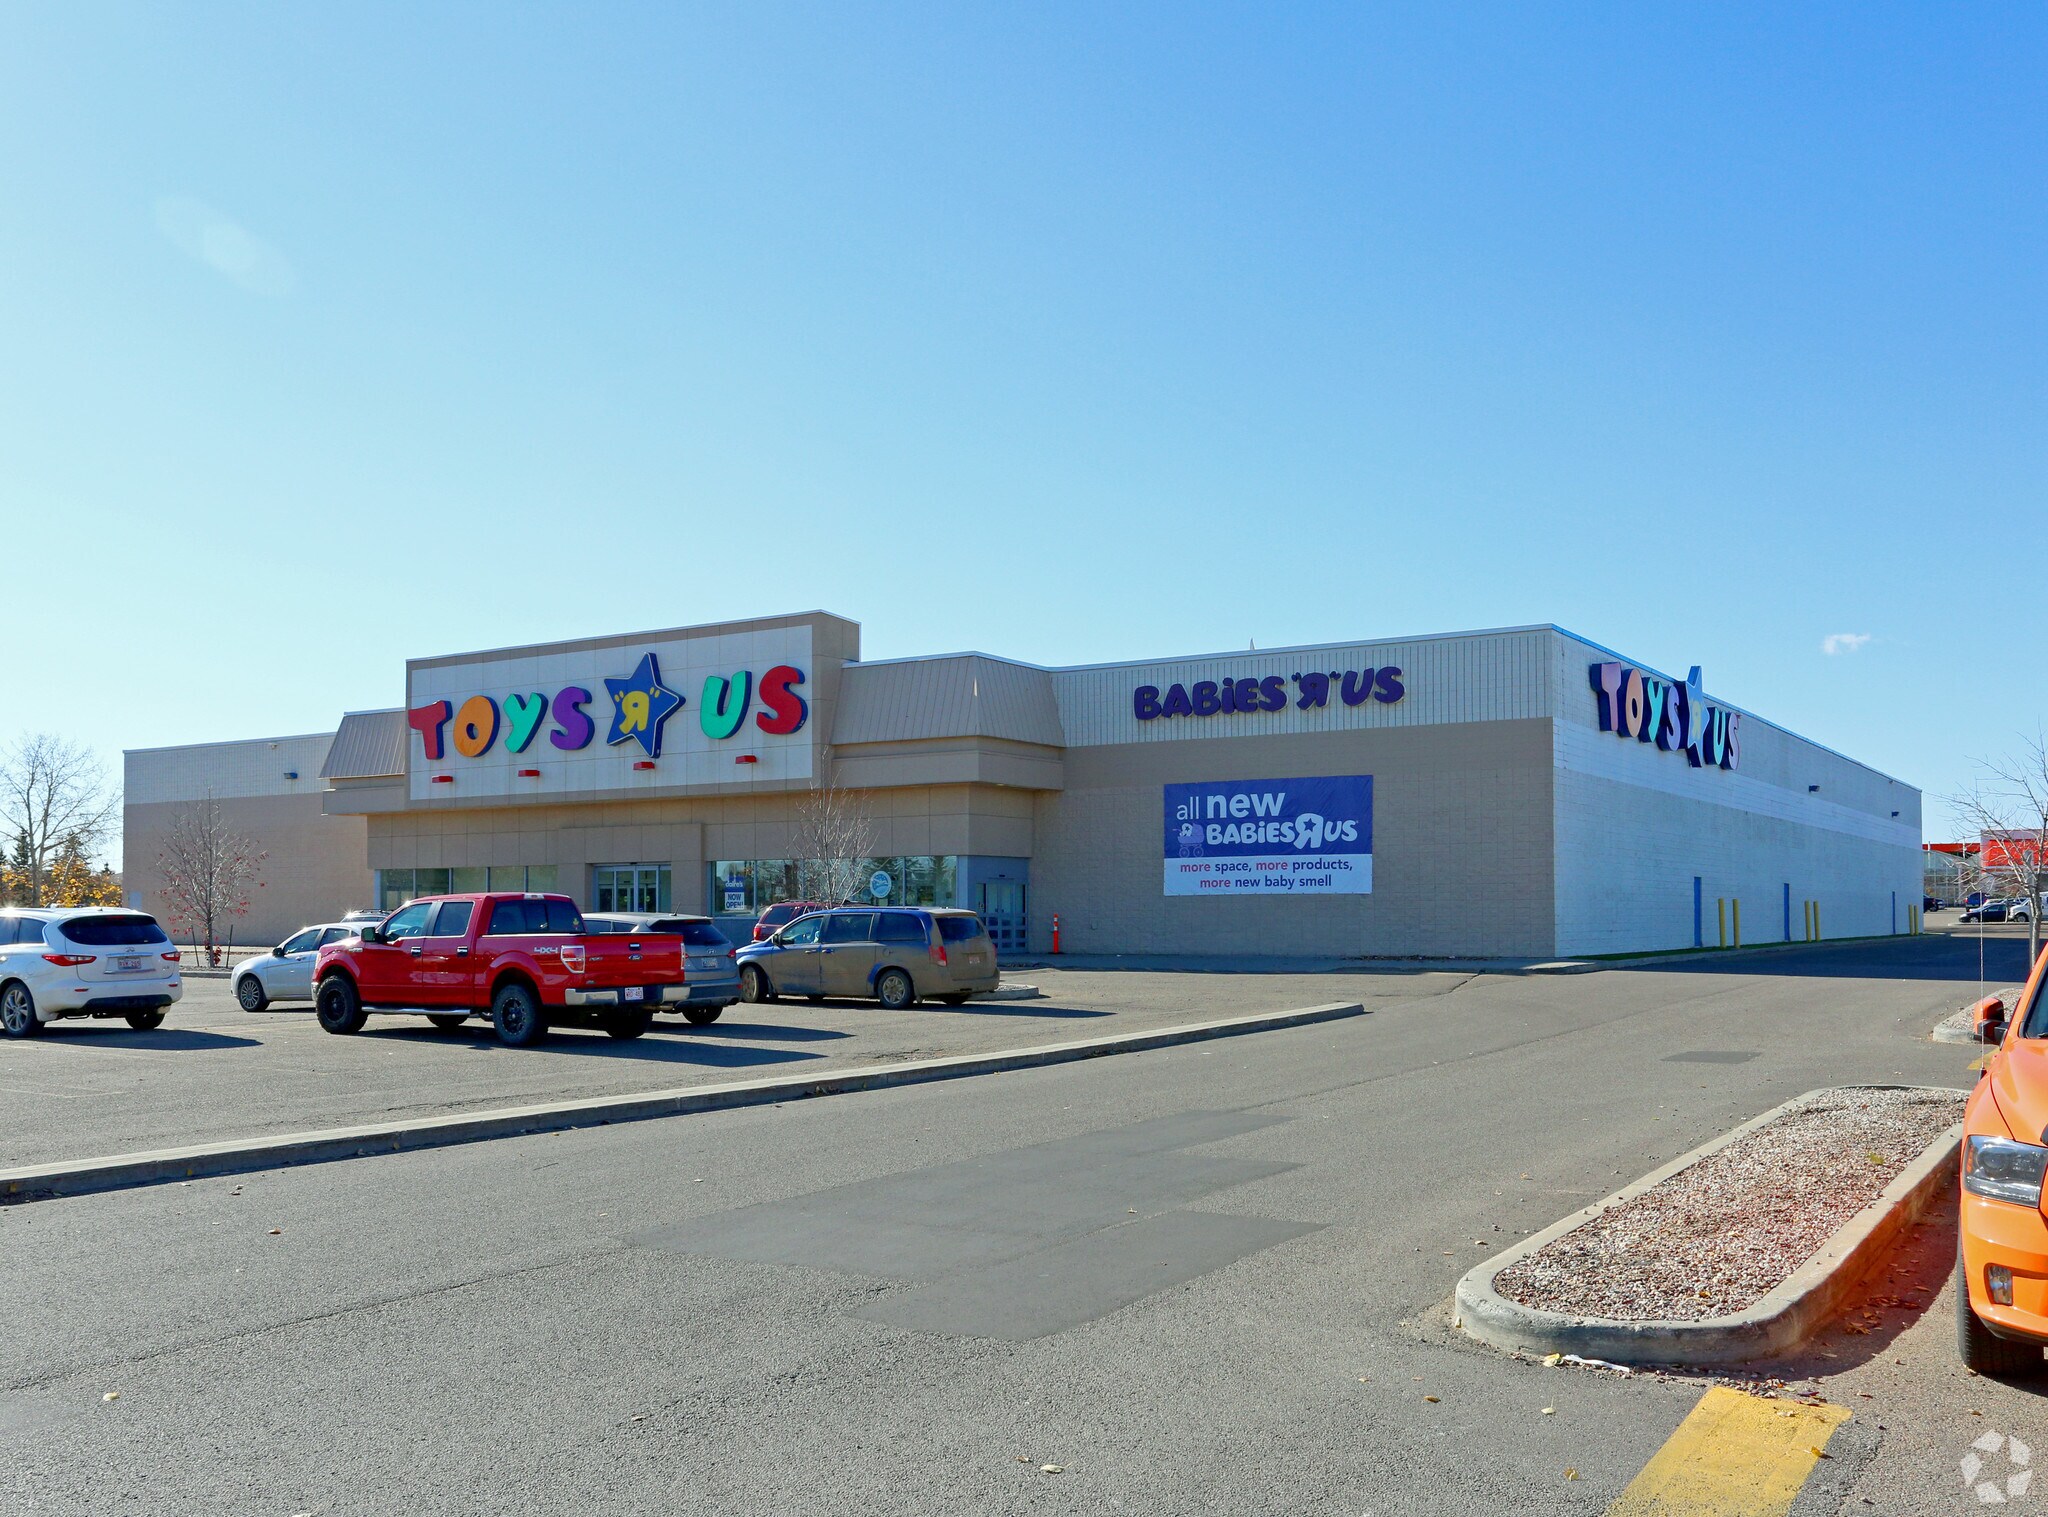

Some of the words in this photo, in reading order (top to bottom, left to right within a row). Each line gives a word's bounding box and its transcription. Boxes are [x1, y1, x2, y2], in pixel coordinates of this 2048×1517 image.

[1341, 666, 1406, 707] US
[408, 686, 595, 759] TOYS
[700, 665, 808, 739] US
[1590, 662, 1681, 751] TOYS
[1704, 706, 1740, 770] US
[1176, 796, 1200, 820] all
[1206, 792, 1286, 819] new
[1180, 862, 1211, 873] more
[1214, 861, 1252, 875] space,
[1255, 861, 1288, 872] more
[1292, 859, 1353, 875] products,
[1200, 877, 1231, 889] more
[1235, 877, 1260, 888] new
[1264, 875, 1295, 890] baby
[1299, 875, 1332, 887] smell
[727, 893, 742, 901] NOW
